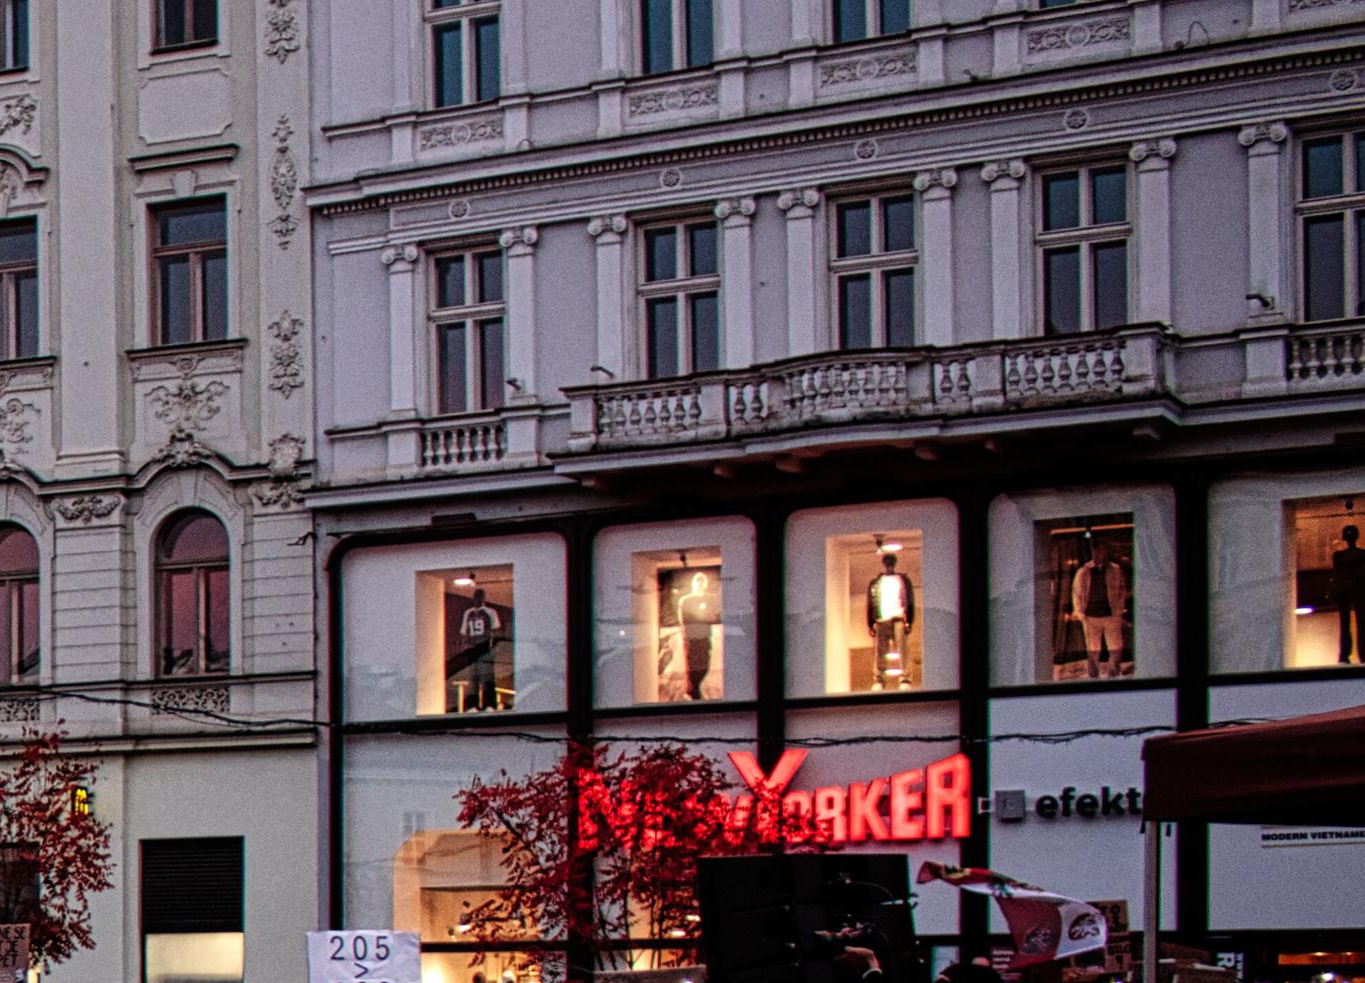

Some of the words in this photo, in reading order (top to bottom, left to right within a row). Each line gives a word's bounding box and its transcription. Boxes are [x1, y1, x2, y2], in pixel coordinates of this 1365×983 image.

[727, 749, 971, 844] YORKER
[1035, 785, 1142, 818] efekt
[1261, 832, 1308, 841] MODERN
[1310, 830, 1365, 840] VIETNAME
[329, 935, 390, 961] 205
